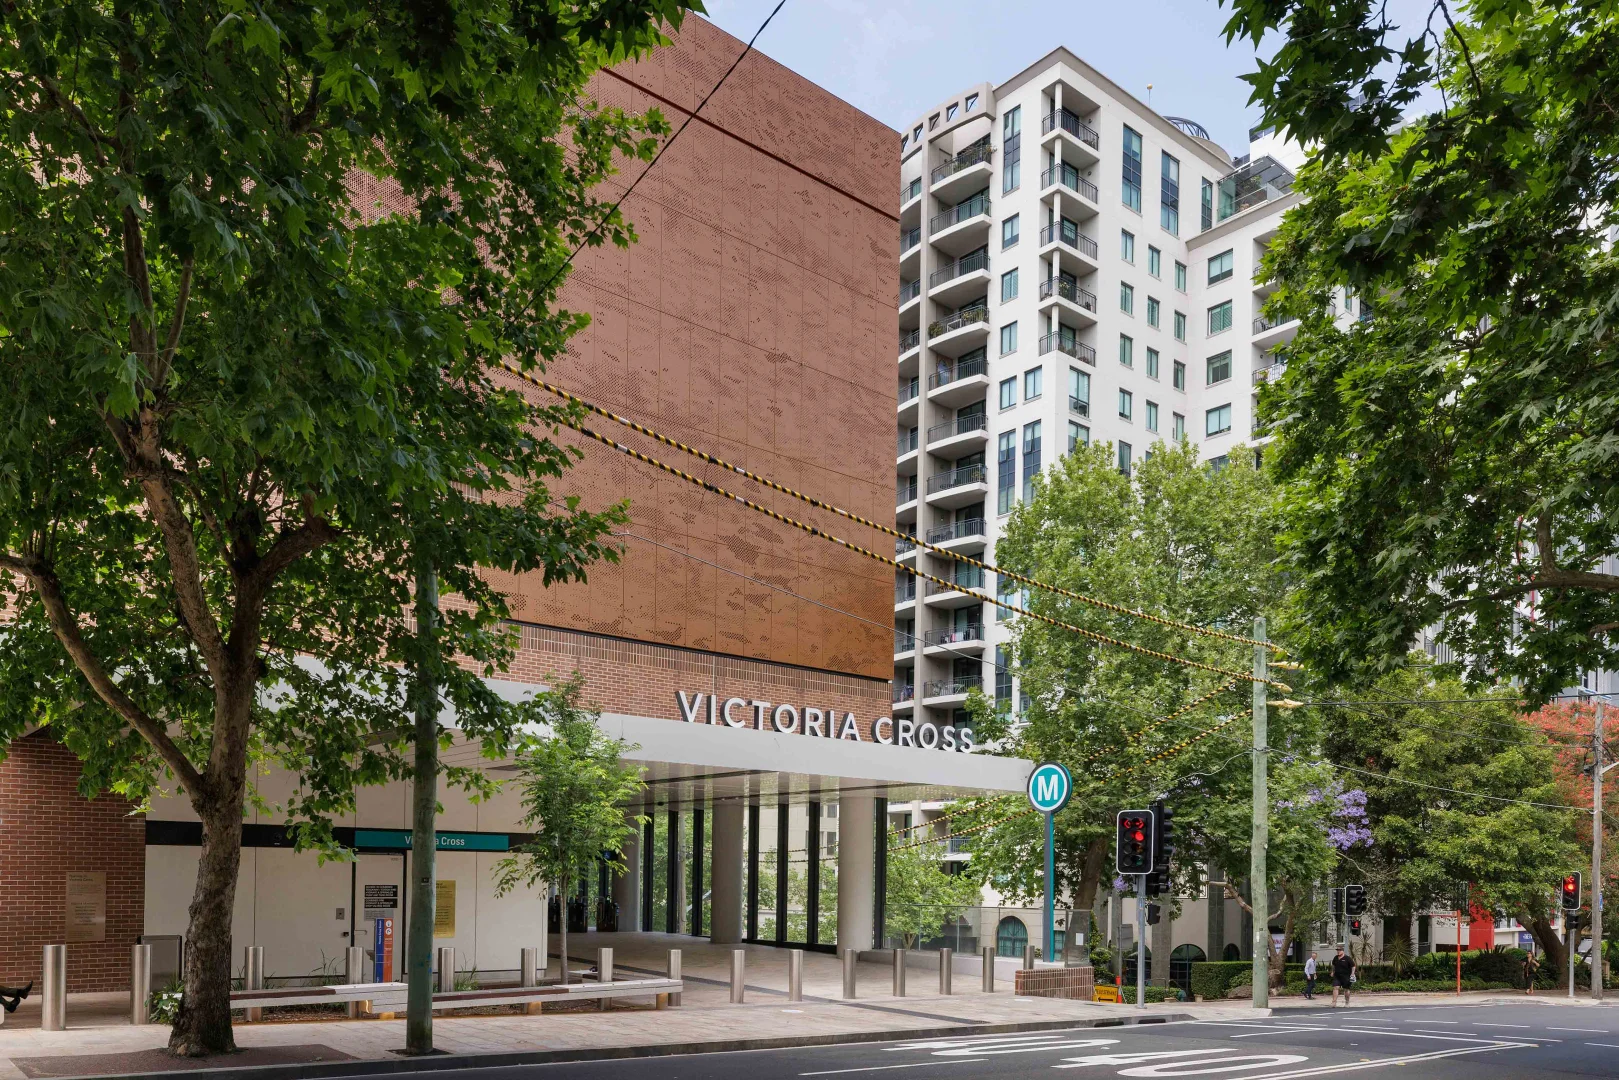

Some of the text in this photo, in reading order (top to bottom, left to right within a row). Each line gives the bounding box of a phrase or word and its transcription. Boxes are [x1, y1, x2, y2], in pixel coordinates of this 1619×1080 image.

[675, 690, 974, 754] VICTORIA CROSS
[1037, 774, 1059, 802] M
[441, 836, 465, 846] Cross
[880, 1035, 1121, 1056] 40
[1050, 1047, 1309, 1077] 40
